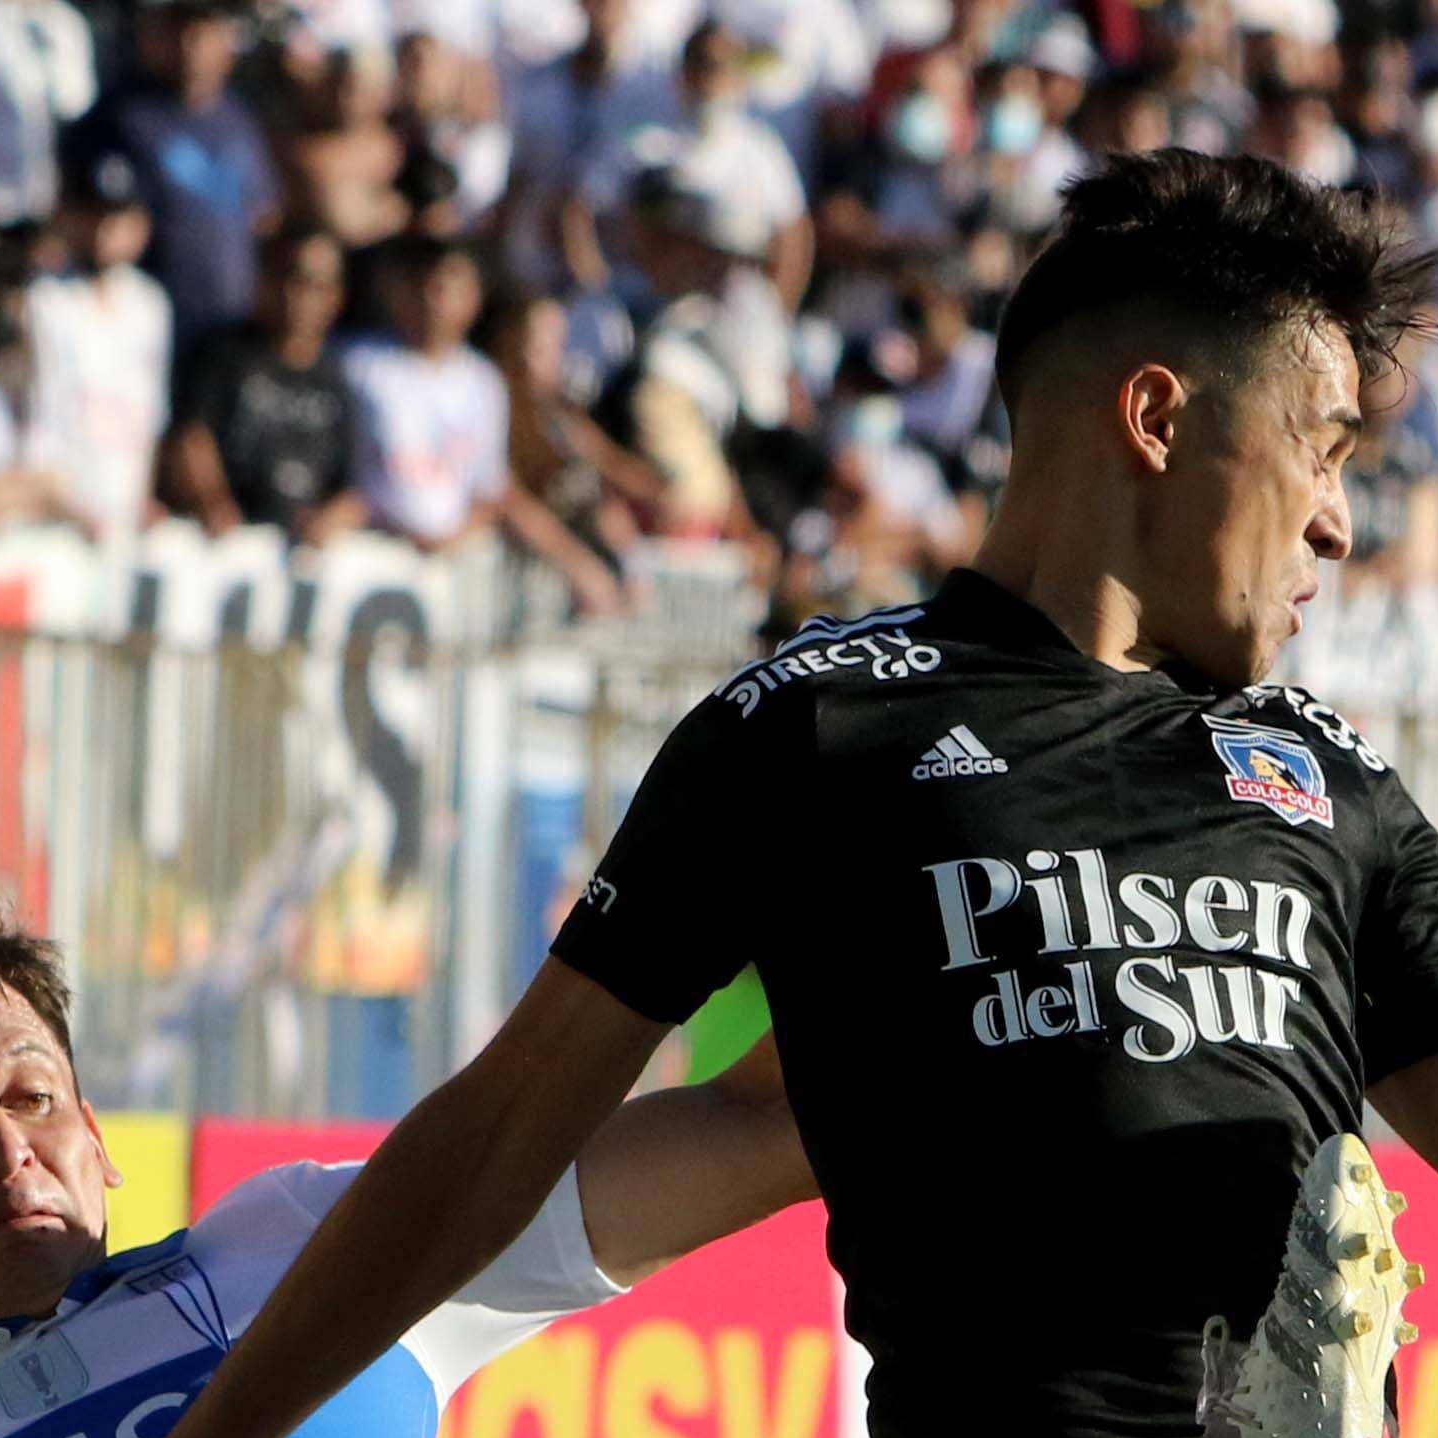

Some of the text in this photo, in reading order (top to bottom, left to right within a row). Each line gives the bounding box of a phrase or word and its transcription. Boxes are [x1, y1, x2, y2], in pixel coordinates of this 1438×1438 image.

[726, 628, 912, 719] DIRECTV
[872, 645, 941, 680] GO
[912, 757, 1009, 780] adidas
[1234, 780, 1329, 818] COLO-COLO
[922, 848, 1312, 971] Pilsen
[972, 955, 1301, 1063] del Sur
